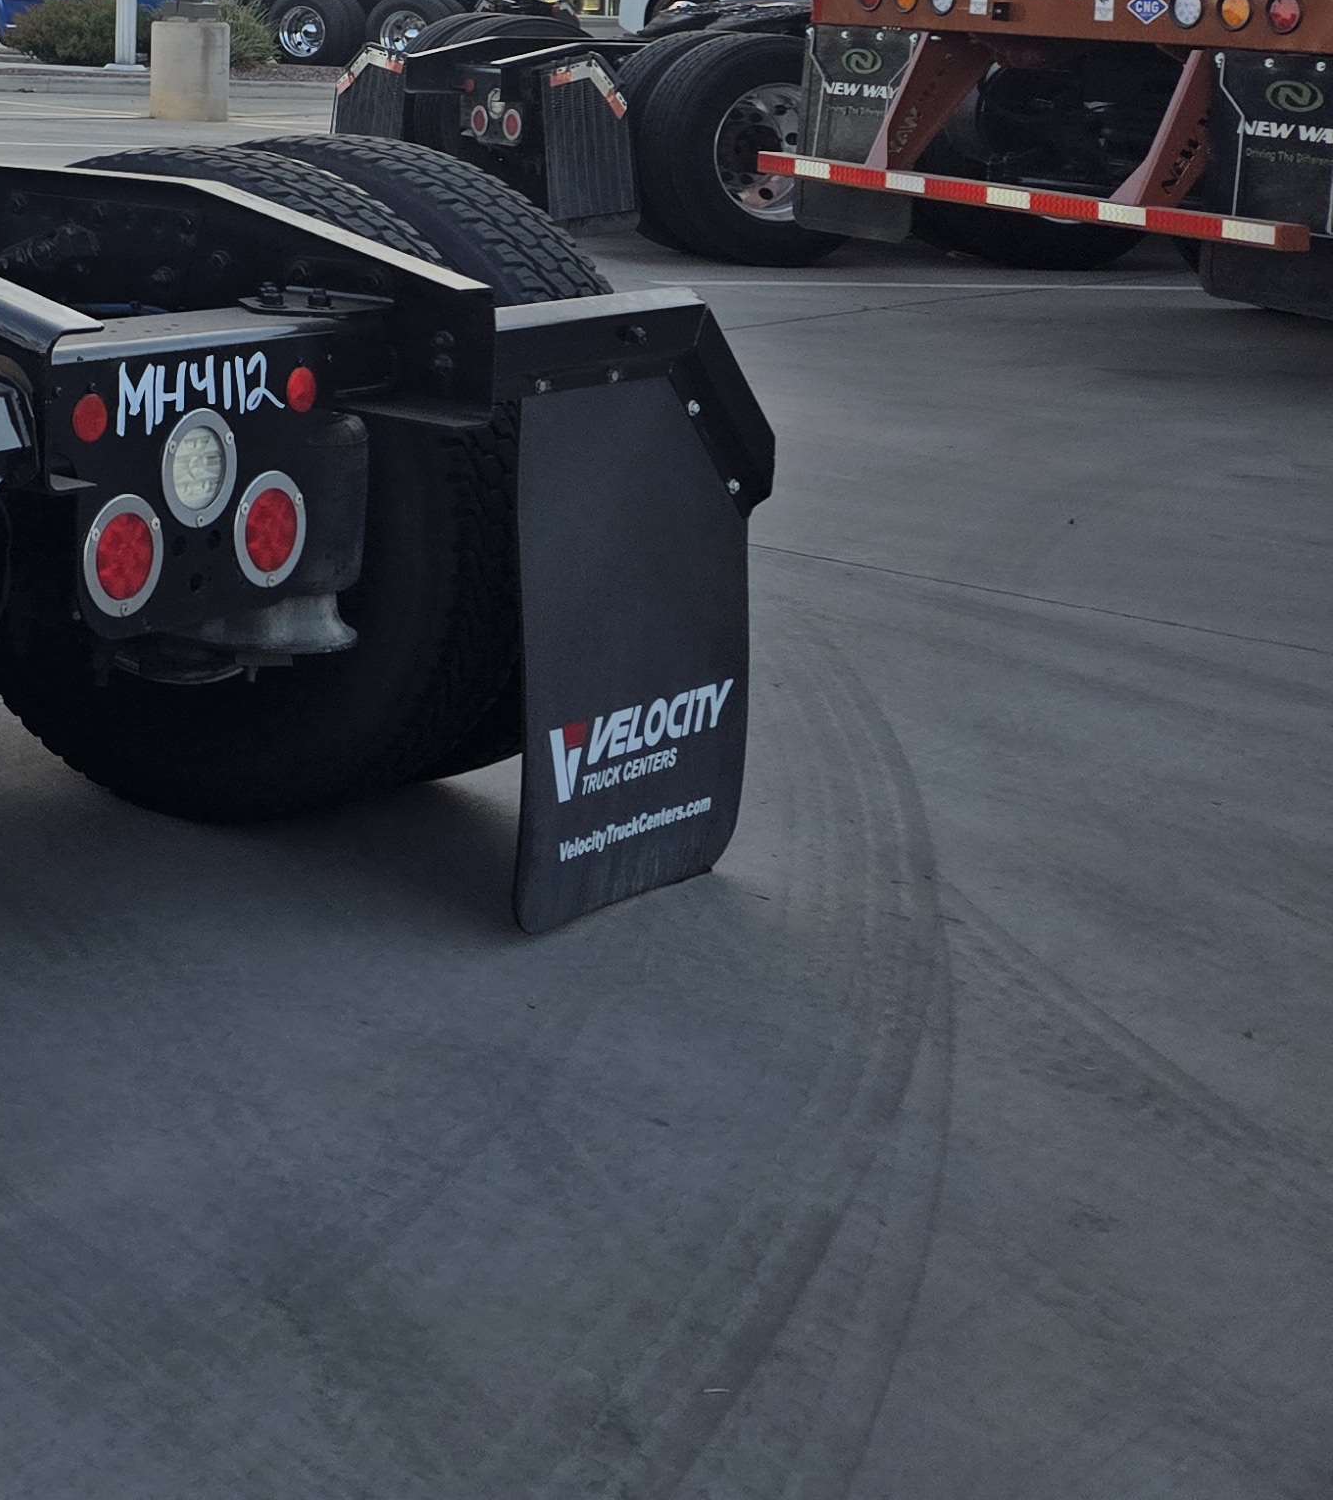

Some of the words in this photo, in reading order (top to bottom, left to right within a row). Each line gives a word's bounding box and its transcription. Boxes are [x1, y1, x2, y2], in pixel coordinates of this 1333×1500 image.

[1135, 0, 1160, 13] CNG
[1237, 120, 1295, 139] NEW
[116, 351, 285, 437] MH4112
[586, 678, 734, 766] VELOCITY
[582, 764, 622, 796] TRUCK
[623, 747, 678, 782] CENTERS
[559, 796, 712, 863] VelocityTruckCenters.com
